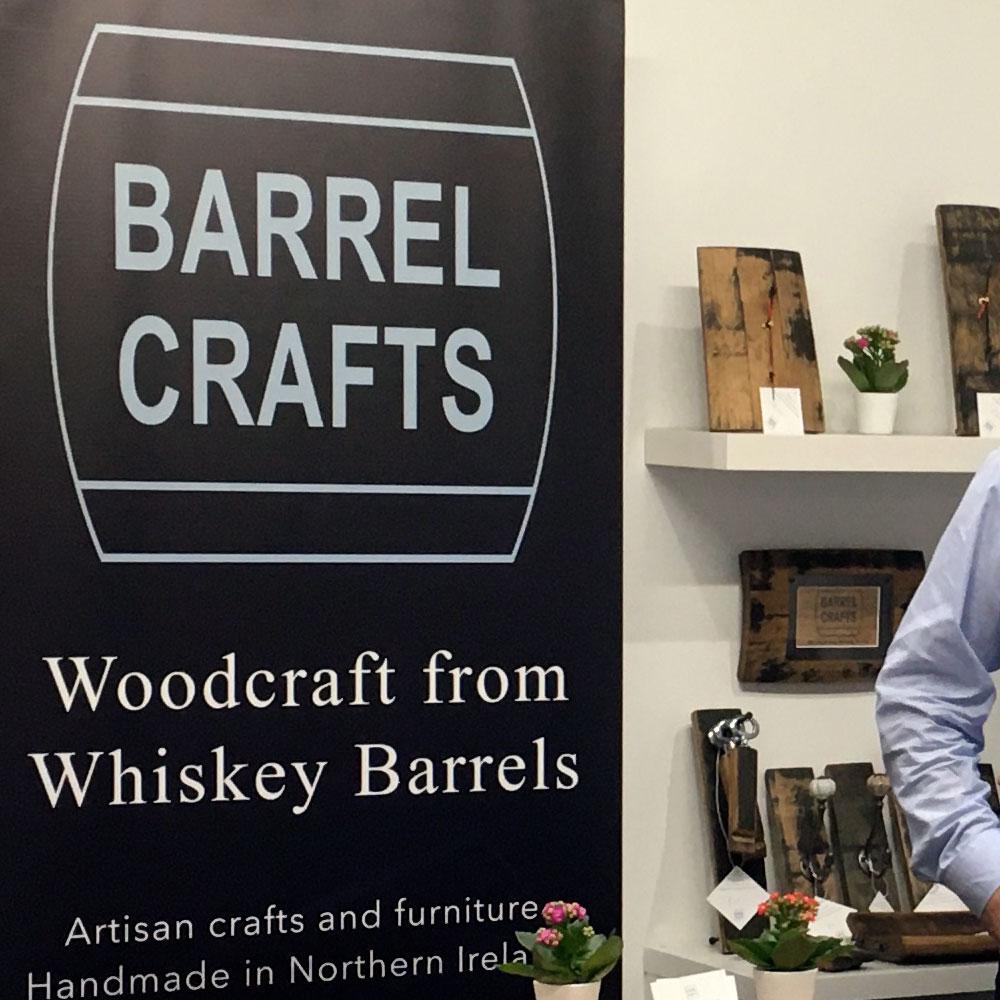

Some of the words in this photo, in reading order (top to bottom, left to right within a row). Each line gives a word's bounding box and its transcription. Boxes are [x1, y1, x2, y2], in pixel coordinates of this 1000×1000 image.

[114, 162, 501, 288] BARREL
[118, 314, 494, 433] CRAFTS
[42, 650, 397, 713] Woodcraft
[422, 649, 570, 705] from
[27, 745, 329, 815] Whiskey
[354, 736, 580, 799] Barrels
[64, 914, 195, 947] Artisan
[209, 903, 305, 940] crafts
[318, 899, 381, 932] and
[394, 896, 539, 927] furniture
[27, 959, 230, 1000] Handmade
[245, 960, 276, 988] in
[290, 949, 444, 985] Northern
[457, 940, 528, 974] Irela
